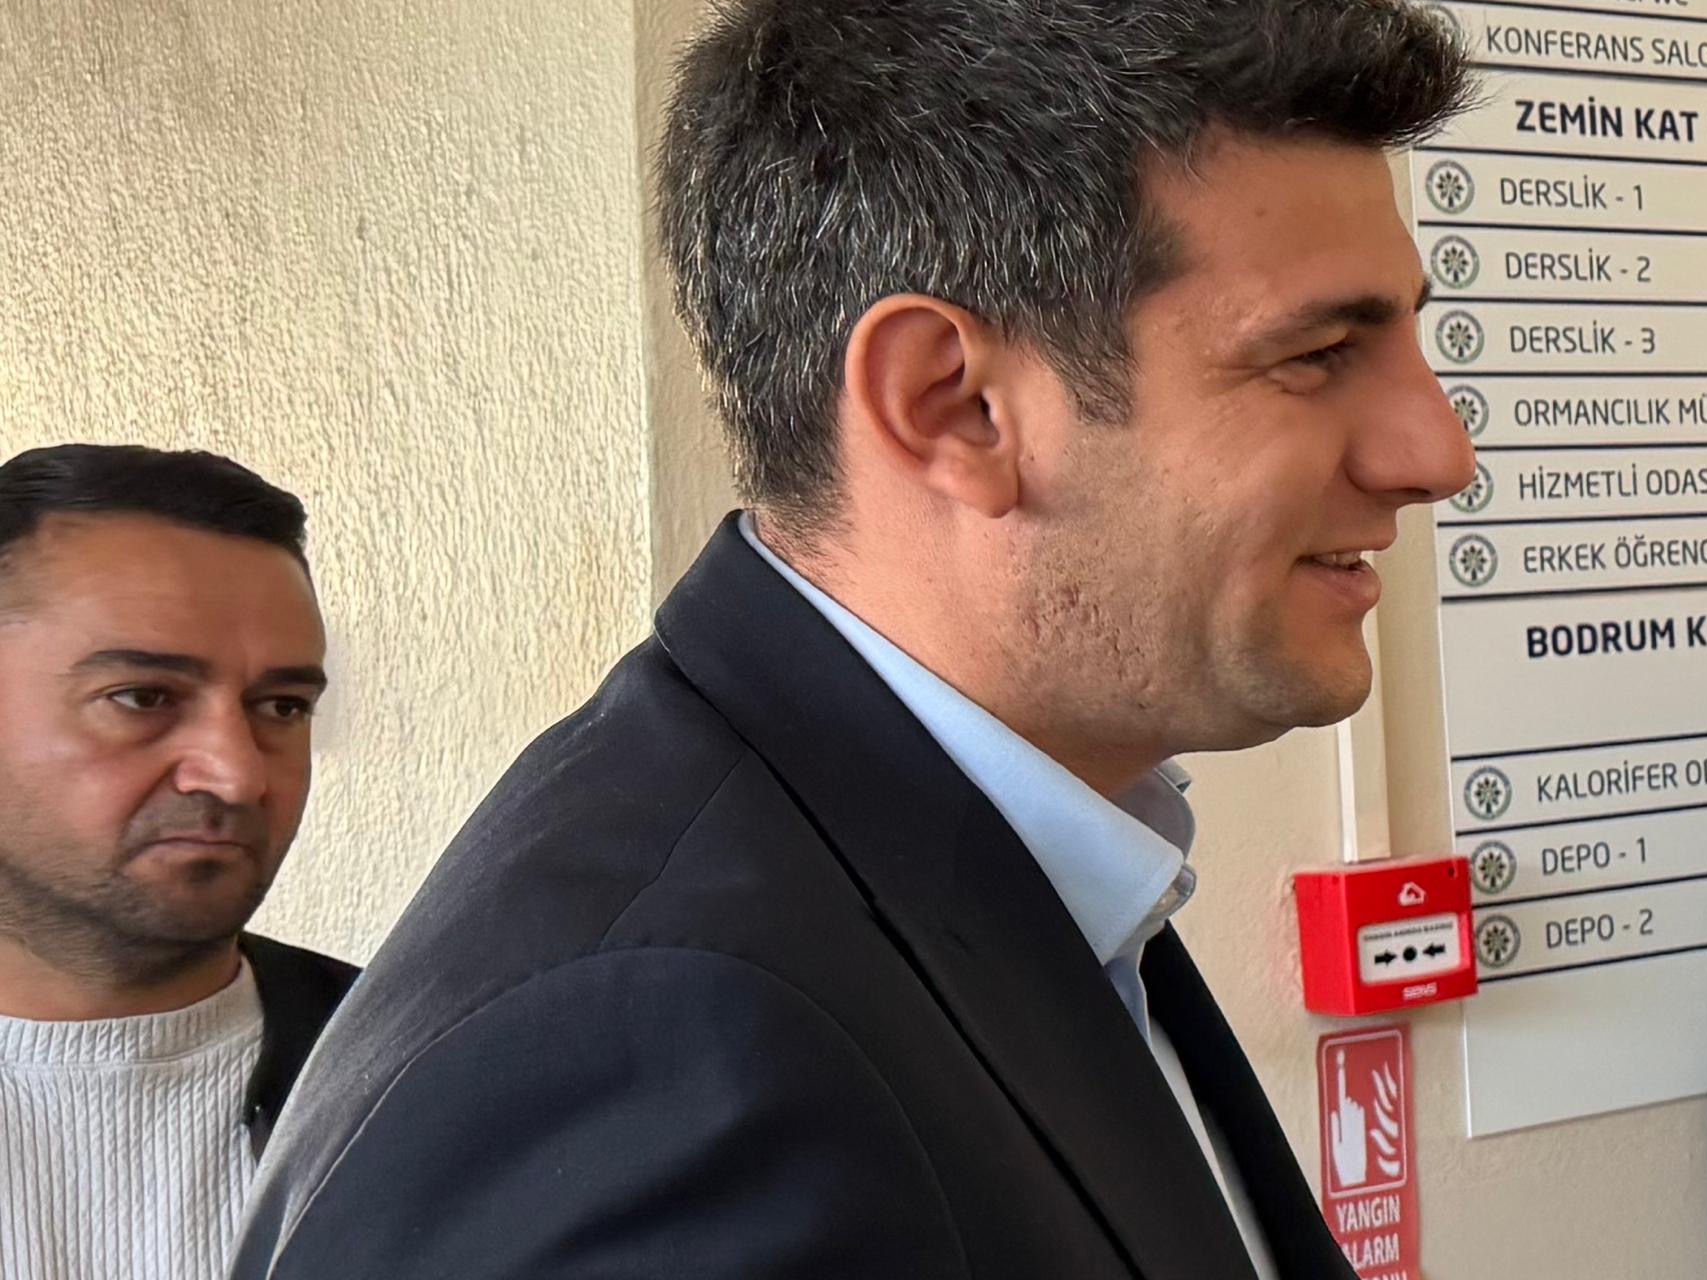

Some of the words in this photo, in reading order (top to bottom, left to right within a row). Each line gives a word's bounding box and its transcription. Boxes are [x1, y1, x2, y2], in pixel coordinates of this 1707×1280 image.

[1486, 26, 1644, 62] KONFERANS
[1515, 96, 1623, 137] ZEMİN
[1635, 108, 1698, 142] KAT
[1500, 175, 1607, 209] DERSLİK
[1633, 185, 1642, 210] 1
[1505, 248, 1611, 281] DERSLİK
[1637, 256, 1651, 282] 2
[1510, 321, 1616, 353] DERSLİK
[1641, 327, 1655, 354] 3
[1514, 399, 1670, 426] ORMANCILIK
[1519, 464, 1637, 500] HİZMETLİ
[1524, 543, 1606, 573] ERKEK
[1526, 619, 1675, 659] BODRUM
[1537, 761, 1678, 802] KALORİFER
[1542, 842, 1610, 875] DEPO
[1637, 837, 1646, 863] 1
[1546, 914, 1614, 949] DEPO
[1640, 908, 1653, 935] 2
[1336, 1195, 1400, 1233] YANGIN
